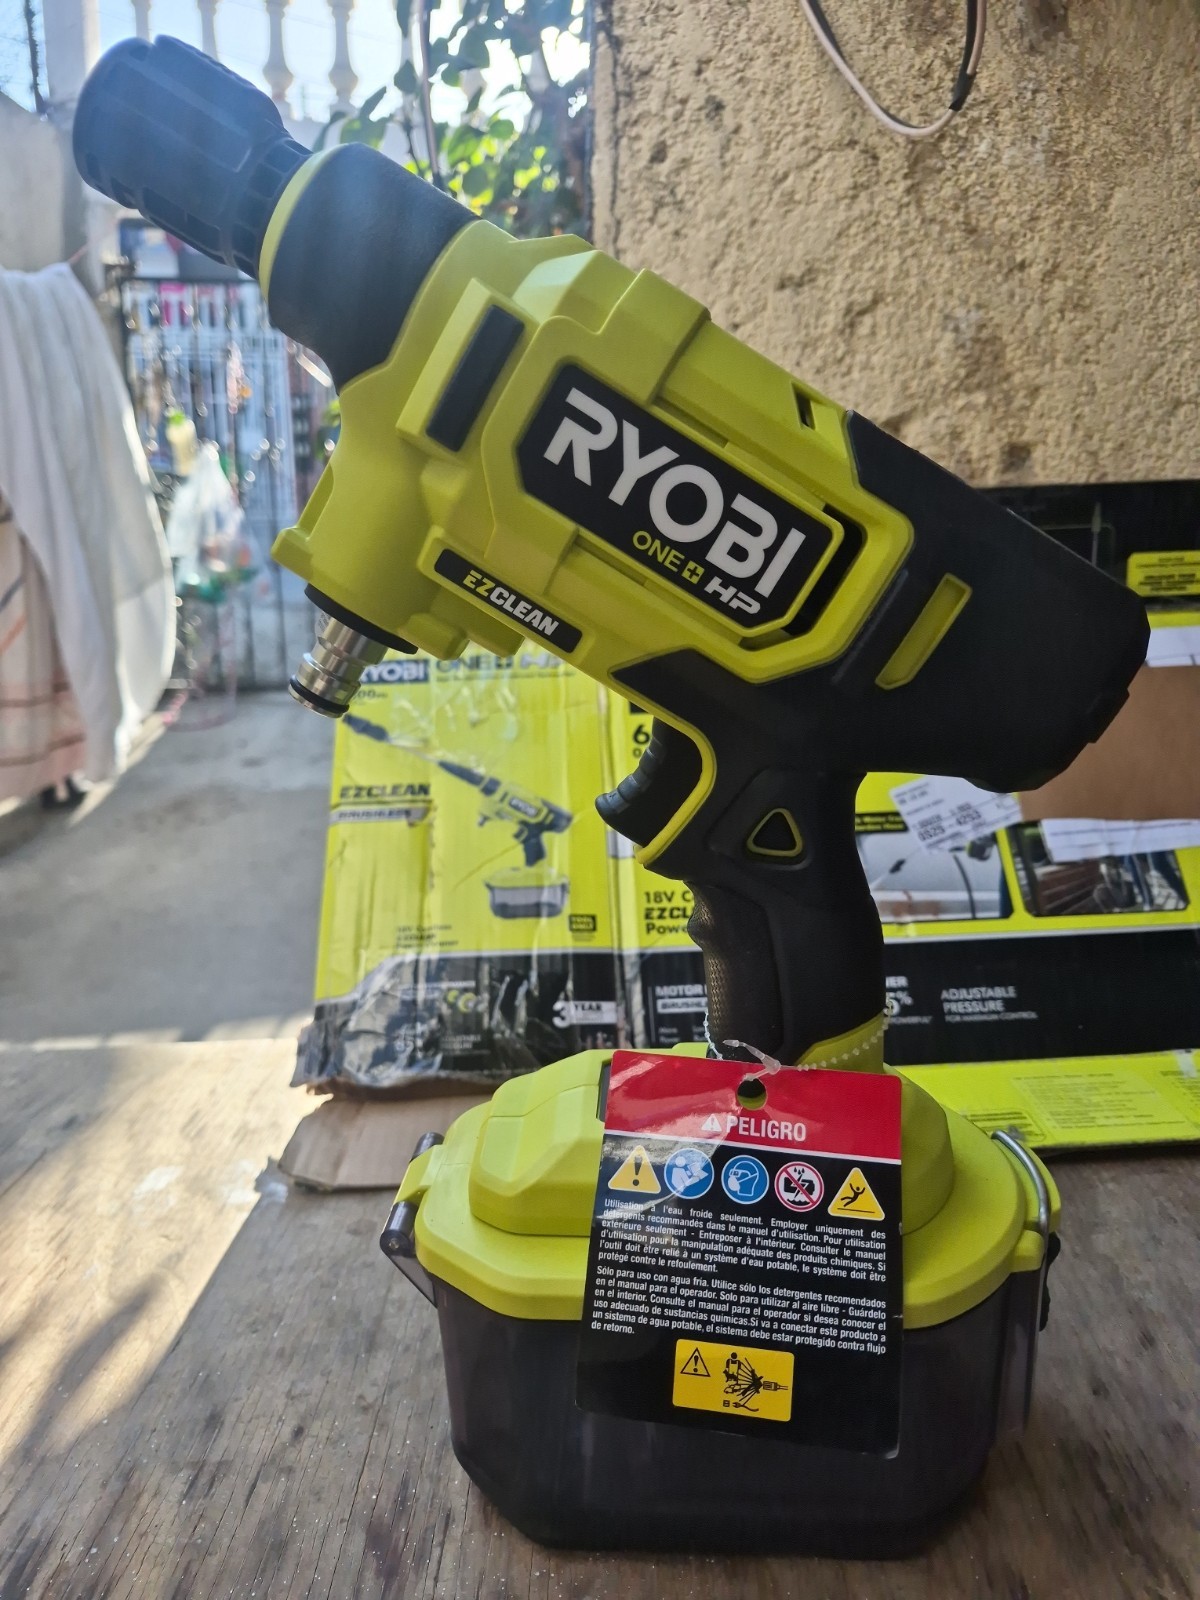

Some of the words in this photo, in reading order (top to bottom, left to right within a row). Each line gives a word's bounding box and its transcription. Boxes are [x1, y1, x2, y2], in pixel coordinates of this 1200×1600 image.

[543, 387, 806, 598] RYOBI
[462, 570, 559, 636] EZCLEAN
[704, 576, 761, 614] HP
[645, 891, 674, 904] 18V
[655, 984, 704, 996] MOTOR
[941, 986, 1017, 1000] ADJUSTABLE
[943, 1000, 1005, 1014] PRESSURE
[552, 1000, 571, 1029] 3
[726, 1115, 806, 1142] PELIGRO
[604, 1198, 644, 1210] Utilisation
[650, 1204, 655, 1212] à
[663, 1205, 682, 1215] l'eau
[690, 1209, 712, 1219] froide
[720, 1214, 763, 1225] seulement.
[771, 1218, 808, 1231] Employer
[815, 1225, 863, 1237] uniquement
[871, 1230, 886, 1240] des
[647, 1216, 703, 1228] recommandés
[706, 1221, 725, 1231] dans
[728, 1224, 735, 1232] le
[739, 1227, 768, 1236] manuel
[771, 1229, 820, 1242] d'utilisation.
[824, 1235, 843, 1245] Pour
[845, 1238, 886, 1250] utilisation
[600, 1240, 621, 1250] l'outil
[625, 1243, 640, 1252] doit
[662, 1248, 680, 1257] relié
[683, 1250, 688, 1258] à
[704, 1254, 738, 1264] système
[741, 1257, 763, 1267] d'eau
[766, 1261, 800, 1273] potable,
[802, 1264, 810, 1273] le
[813, 1267, 847, 1277] système
[850, 1270, 866, 1279] doit
[601, 1230, 647, 1242] d'utilisation
[651, 1237, 669, 1245] pour
[671, 1238, 679, 1246] la
[681, 1241, 733, 1253] manipulation
[736, 1246, 773, 1258] adéquate
[776, 1250, 791, 1260] des
[794, 1254, 827, 1264] produits
[830, 1257, 875, 1270] chimiques.
[877, 1262, 886, 1271] Si
[602, 1220, 641, 1231] extérieure
[645, 1226, 687, 1237] seulement
[699, 1231, 742, 1243] Entreposer
[746, 1236, 751, 1244] à
[756, 1238, 796, 1250] l'intérieur.
[800, 1243, 839, 1255] Consulter
[843, 1248, 850, 1256] le
[855, 1251, 886, 1261] manuel
[598, 1252, 628, 1263] protégé
[631, 1256, 656, 1265] contre
[658, 1258, 665, 1266] le
[668, 1260, 718, 1272] refoulement.
[597, 1266, 614, 1275] Sólo
[616, 1270, 634, 1278] para
[637, 1272, 651, 1280] uso
[653, 1274, 668, 1282] con
[670, 1277, 690, 1286] agua
[711, 1280, 737, 1290] Utilice
[739, 1284, 756, 1293] sólo
[759, 1286, 771, 1295] los
[773, 1287, 822, 1301] detergentes
[825, 1295, 886, 1309] recomendados
[608, 1279, 615, 1287] el
[617, 1281, 647, 1291] manual
[649, 1285, 667, 1294] para
[670, 1286, 677, 1294] el
[680, 1289, 717, 1299] operador.
[720, 1292, 737, 1302] Solo
[740, 1296, 758, 1304] para
[761, 1297, 790, 1308] utilizar
[792, 1301, 799, 1309] al
[802, 1302, 818, 1311] aire
[820, 1304, 839, 1314] libre
[849, 1307, 886, 1319] Guárdelo
[591, 1321, 601, 1329] de
[603, 1323, 634, 1334] retorno.
[607, 1290, 614, 1298] el
[617, 1291, 647, 1302] interior.
[650, 1295, 685, 1306] Consulte
[688, 1300, 695, 1308] el
[699, 1302, 729, 1312] manual
[732, 1306, 750, 1315] para
[753, 1308, 761, 1316] el
[763, 1310, 801, 1321] operador
[804, 1314, 811, 1322] si
[814, 1315, 838, 1325] desea
[841, 1320, 875, 1330] conocer
[878, 1323, 886, 1331] el
[610, 1302, 650, 1313] adecuado
[652, 1306, 661, 1315] de
[664, 1309, 708, 1321] sustancias
[781, 1324, 817, 1334] conectar
[820, 1328, 837, 1336] este
[840, 1331, 878, 1341] producto
[604, 1312, 635, 1323] sistema
[638, 1315, 648, 1324] de
[649, 1319, 670, 1328] agua
[671, 1321, 704, 1332] potable,
[706, 1324, 714, 1332] el
[715, 1325, 748, 1336] sistema
[750, 1329, 770, 1339] debe
[772, 1333, 793, 1342] estar
[795, 1336, 836, 1348] protegido
[837, 1342, 865, 1351] contra
[867, 1344, 886, 1355] flujo
